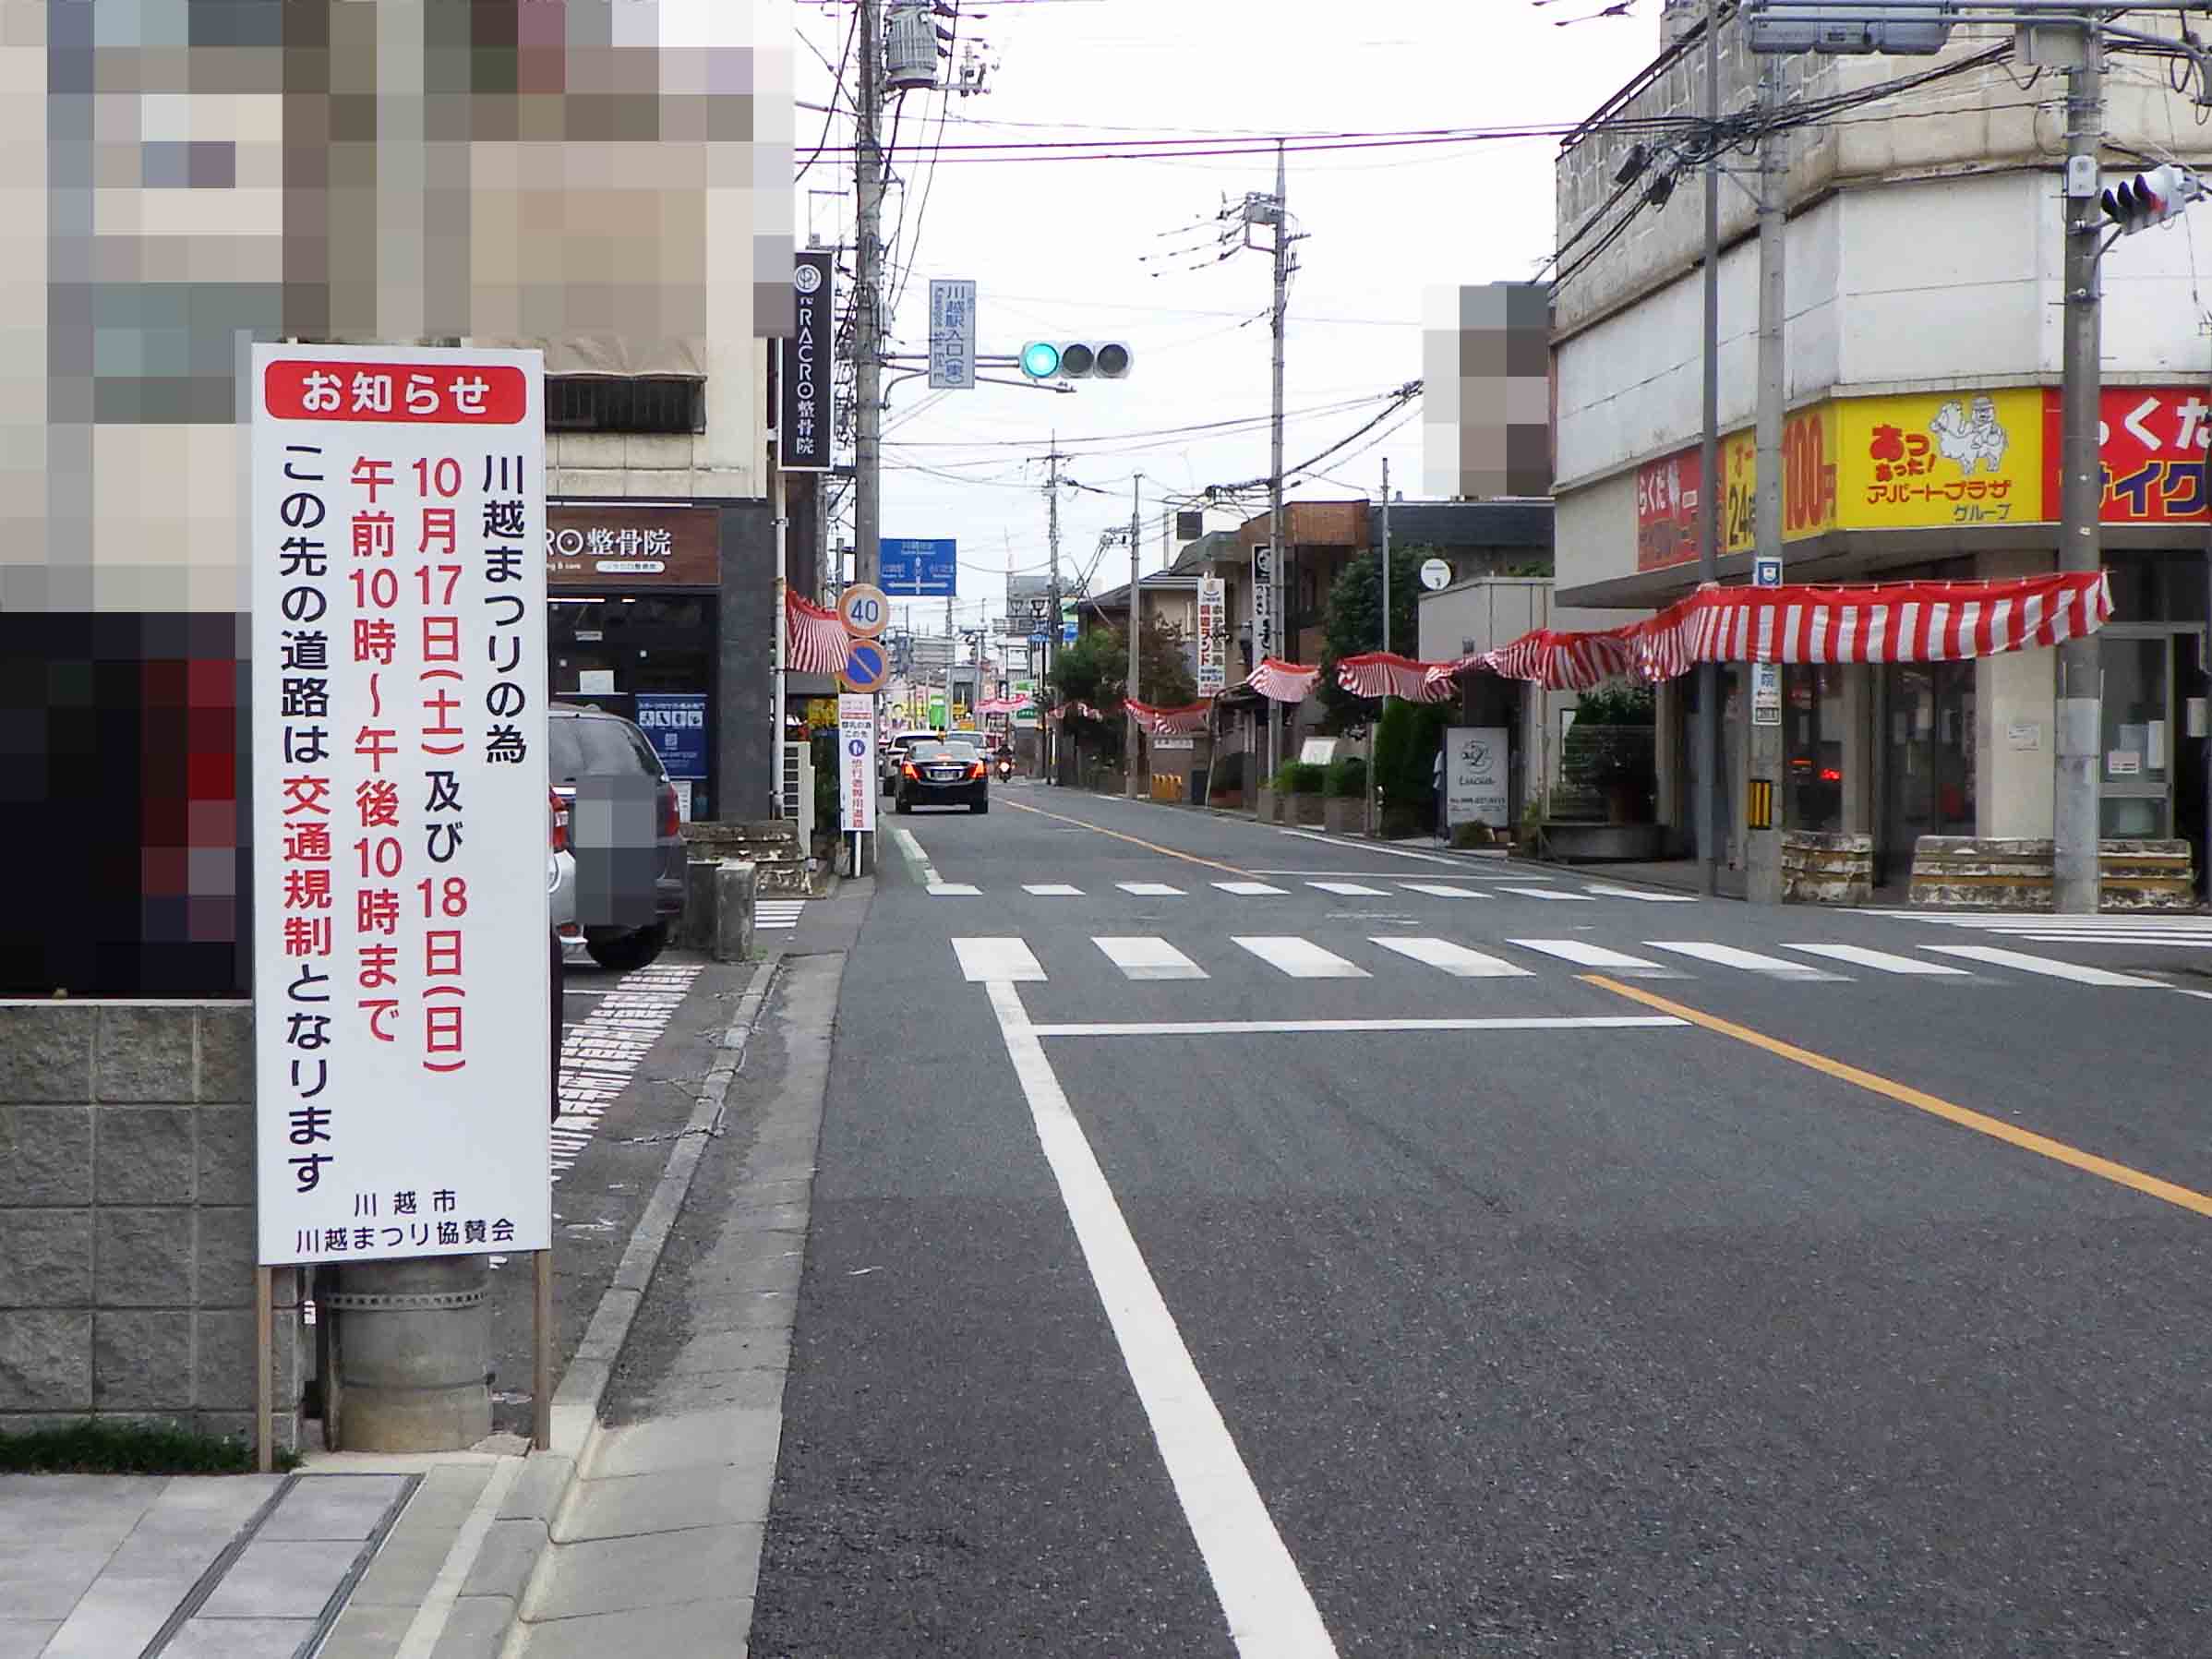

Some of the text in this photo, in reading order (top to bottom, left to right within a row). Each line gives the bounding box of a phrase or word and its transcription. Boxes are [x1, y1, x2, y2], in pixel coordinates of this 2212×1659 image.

[301, 370, 490, 415] お知らせ
[481, 454, 528, 764] 川越まつりの為
[849, 598, 880, 624] 40
[279, 444, 334, 1195] この先の道路は交通規制となります
[355, 1189, 457, 1218] 川越市
[295, 1219, 516, 1254] 川越まつり協賛会
